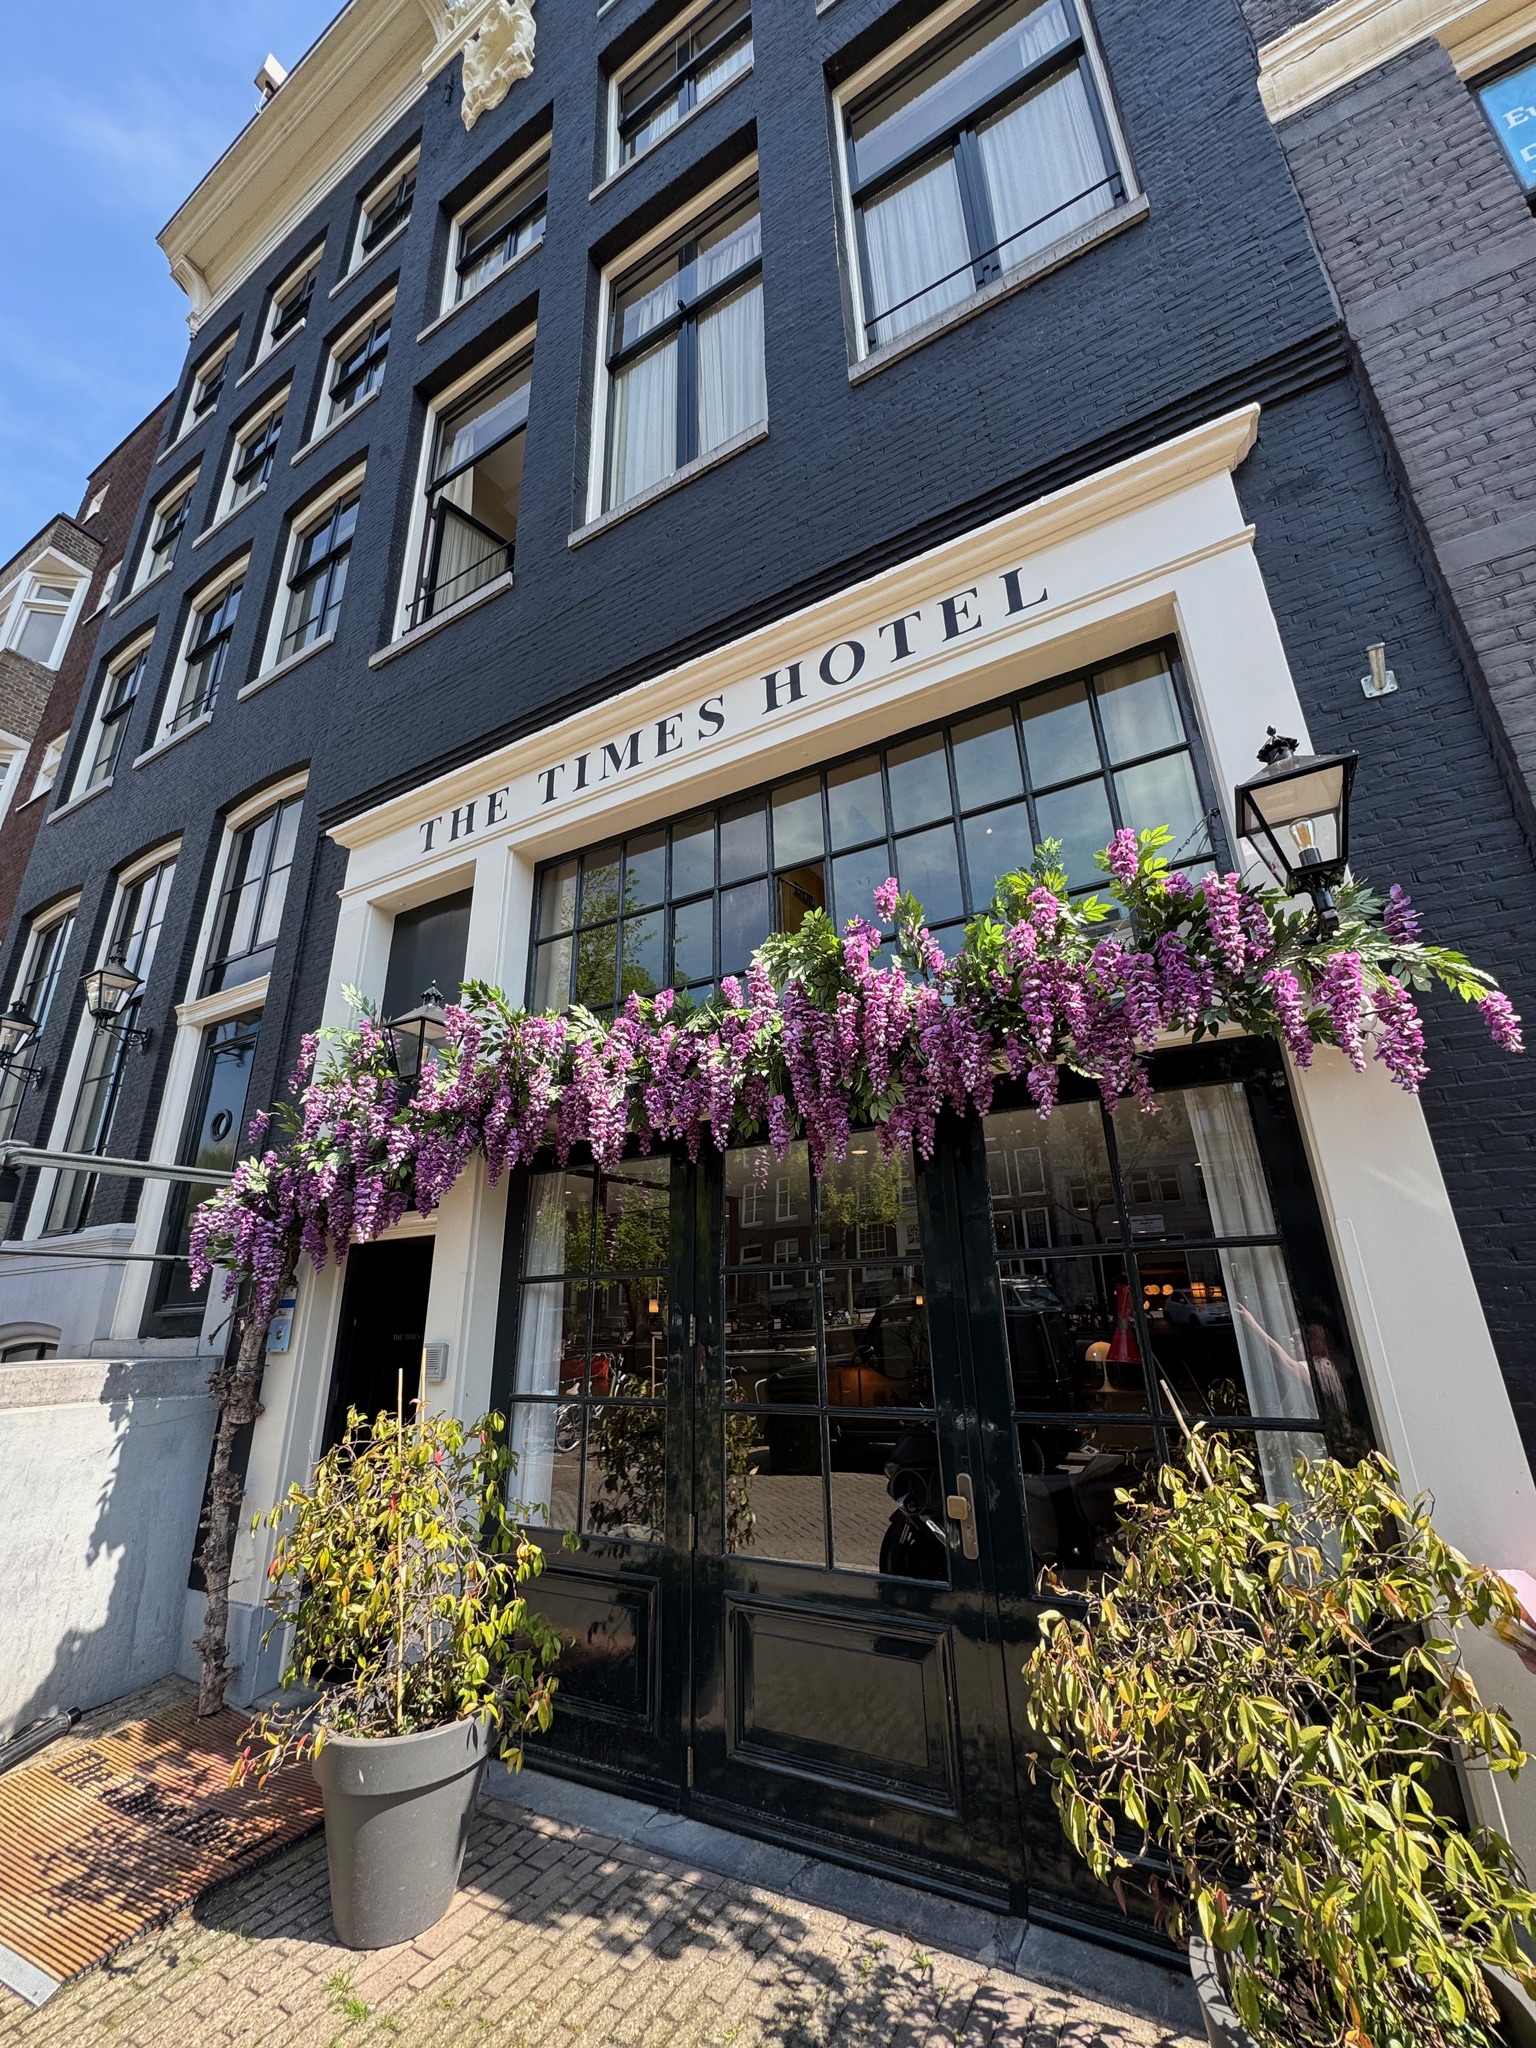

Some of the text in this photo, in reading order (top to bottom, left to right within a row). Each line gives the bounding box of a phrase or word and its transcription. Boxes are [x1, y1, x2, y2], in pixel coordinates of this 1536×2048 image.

[419, 566, 1049, 854] THE TIMES HOTEL
